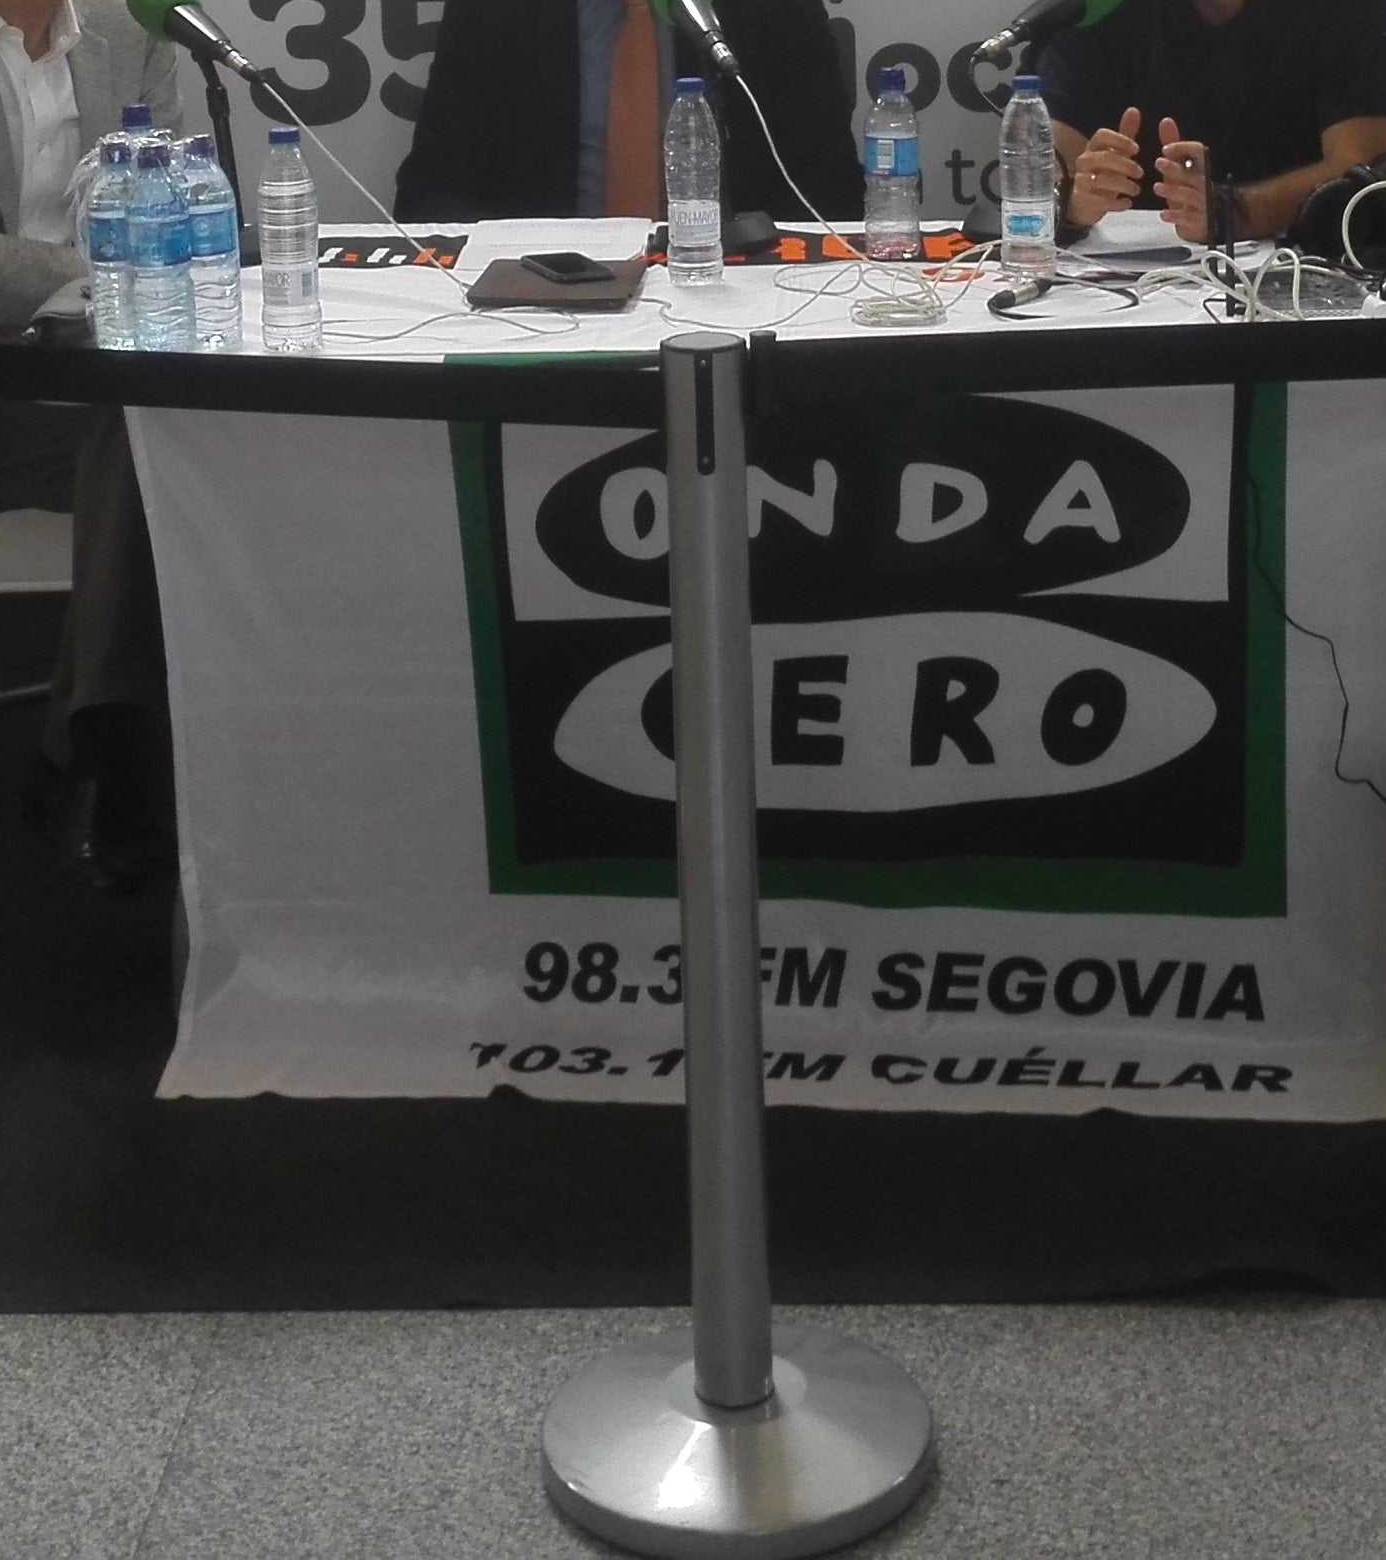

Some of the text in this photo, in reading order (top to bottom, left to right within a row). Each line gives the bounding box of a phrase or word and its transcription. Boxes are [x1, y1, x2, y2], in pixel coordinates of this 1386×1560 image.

[599, 458, 1121, 561] ONDA
[871, 951, 1265, 1022] SEGOVIA
[870, 1046, 1293, 1093] CUÉLLAR
